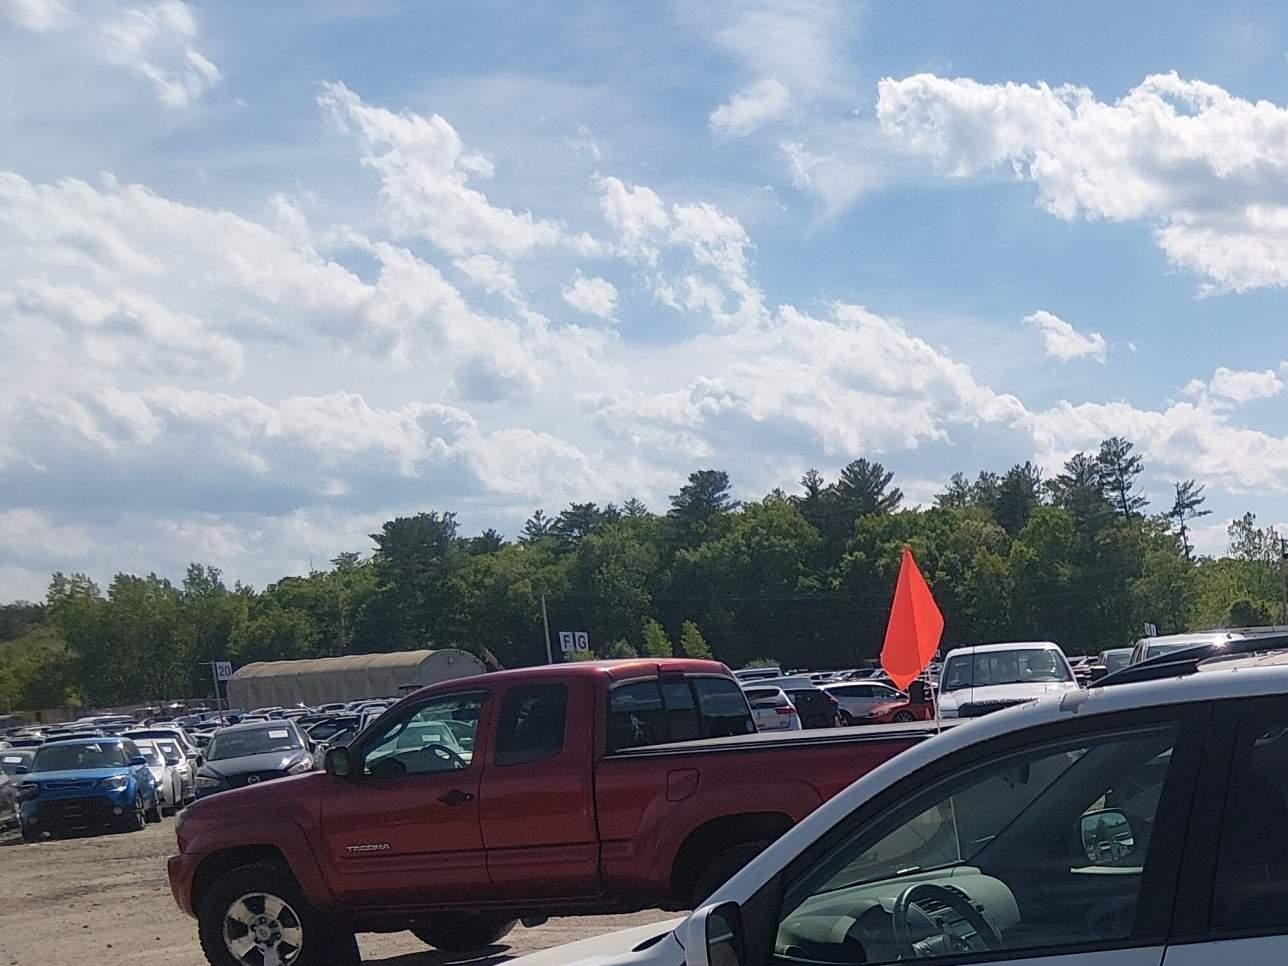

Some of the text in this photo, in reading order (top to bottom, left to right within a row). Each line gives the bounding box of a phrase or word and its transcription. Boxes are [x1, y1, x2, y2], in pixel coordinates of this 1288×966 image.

[563, 635, 587, 649] F G
[218, 665, 231, 677] 20
